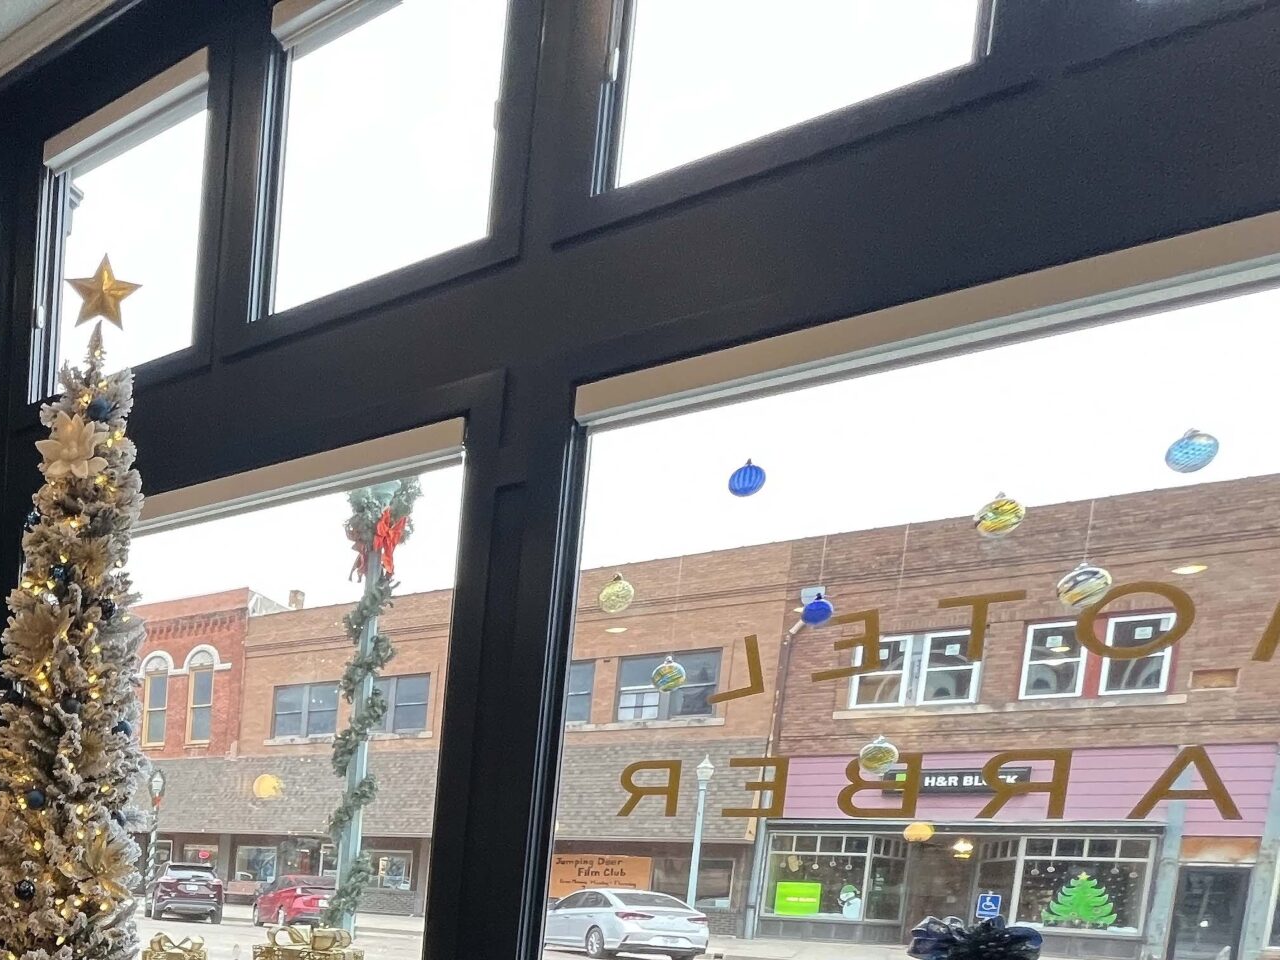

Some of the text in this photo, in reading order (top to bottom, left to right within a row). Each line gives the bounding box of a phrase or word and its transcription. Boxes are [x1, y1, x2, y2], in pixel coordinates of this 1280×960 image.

[924, 775, 1019, 787] H&R BLK
[555, 857, 624, 869] Jumping Deer
[577, 867, 627, 877] Film Club
